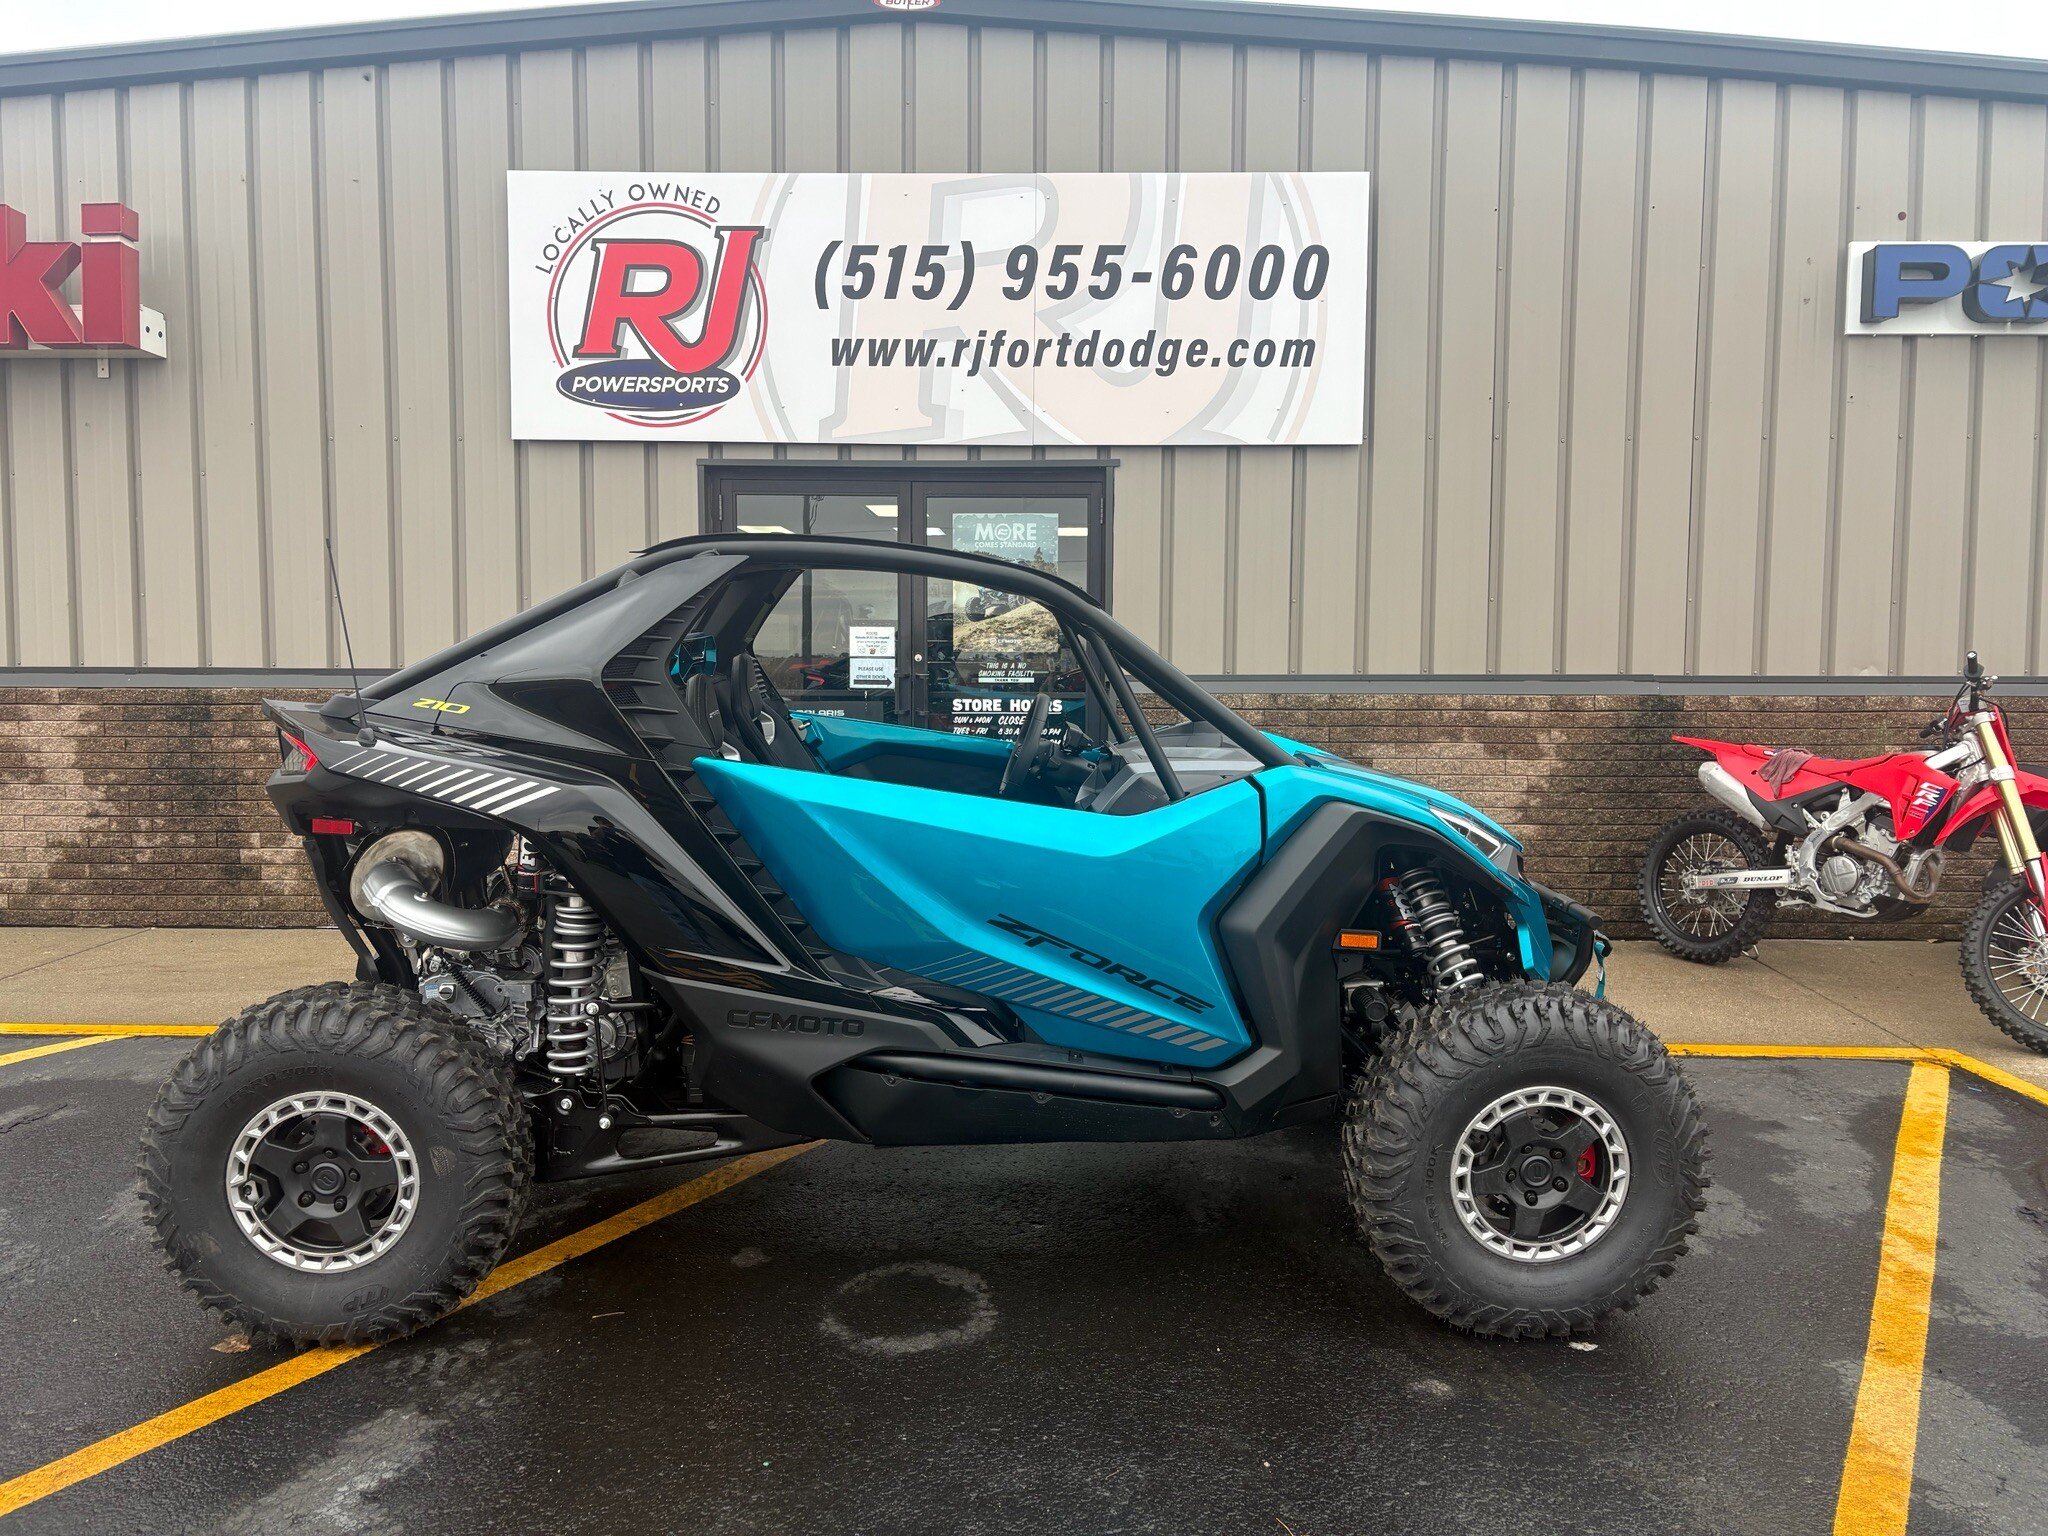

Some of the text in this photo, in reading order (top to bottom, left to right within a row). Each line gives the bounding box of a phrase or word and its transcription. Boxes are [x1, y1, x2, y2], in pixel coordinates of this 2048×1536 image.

[535, 182, 721, 274] LOCALLY OWNED
[814, 240, 1331, 310] (515) 955-6000
[572, 225, 769, 374] RJ
[830, 329, 1317, 377] www.rjfortdodge.com
[571, 376, 730, 394] POWERSPORTS
[974, 522, 1037, 541] MORE
[952, 699, 1063, 712] STORE HOS
[953, 716, 969, 724] SUN
[974, 716, 993, 724] MON
[998, 716, 1026, 725] CLOSE
[953, 727, 970, 735] TUES
[976, 727, 989, 735] FRI
[1743, 875, 1783, 883] DUNLOP
[986, 913, 1216, 1015] ZFORCE
[726, 1009, 865, 1038] CFMOTO
